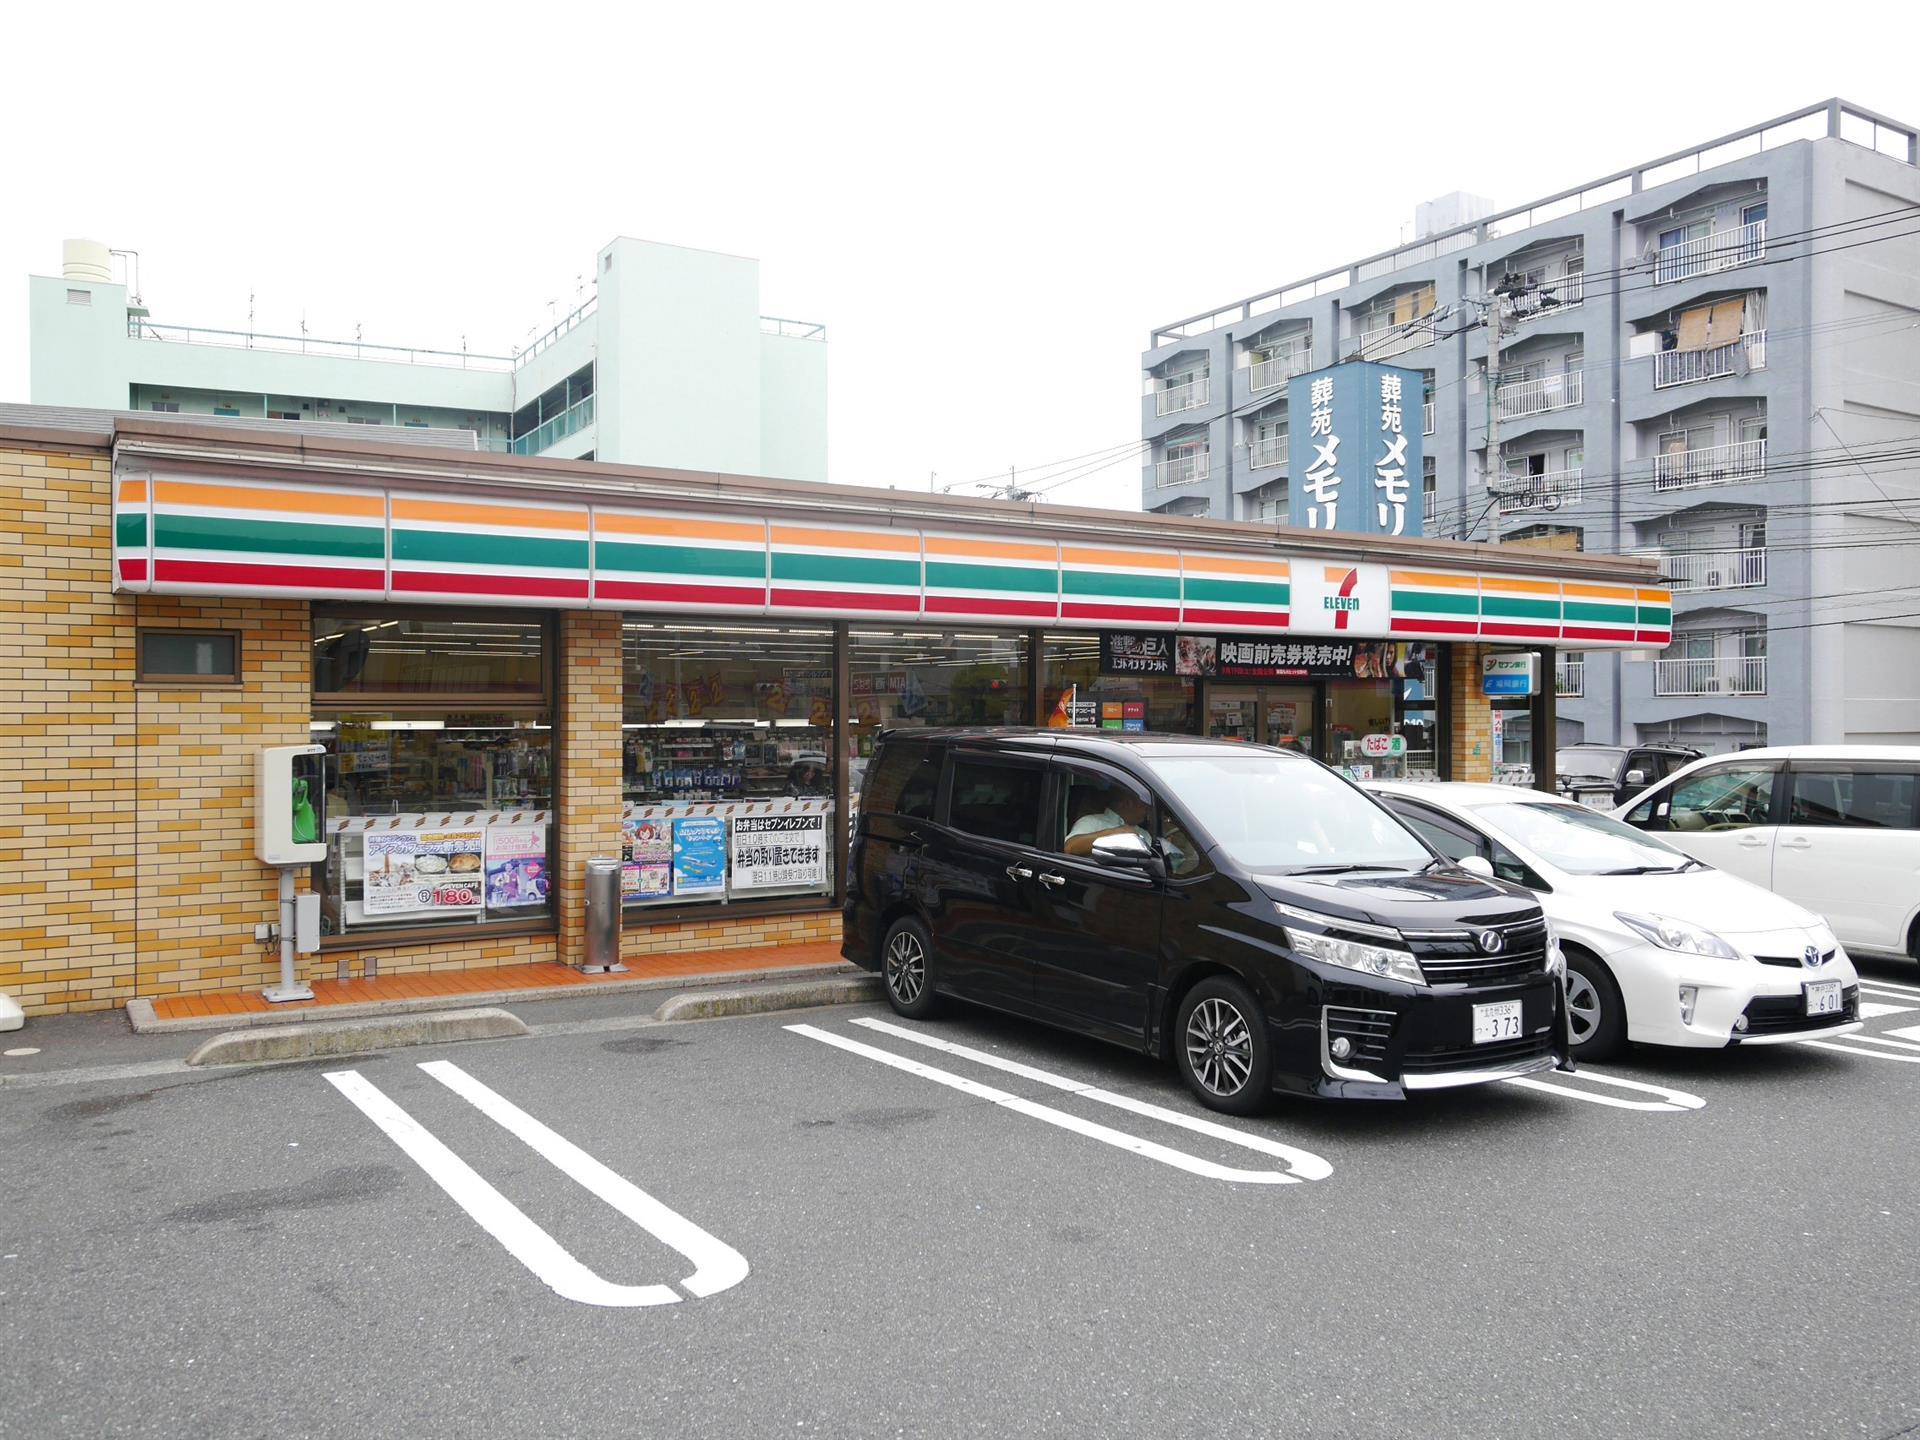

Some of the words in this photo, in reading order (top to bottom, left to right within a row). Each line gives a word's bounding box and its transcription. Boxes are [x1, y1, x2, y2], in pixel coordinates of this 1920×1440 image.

[1110, 634, 1169, 656] 進撃の巨人
[1220, 642, 1353, 666] 映画前売券発売中!
[1367, 737, 1388, 751] たばこ
[1391, 737, 1401, 751] 酒
[737, 845, 820, 869] 弁当の取り置きできます
